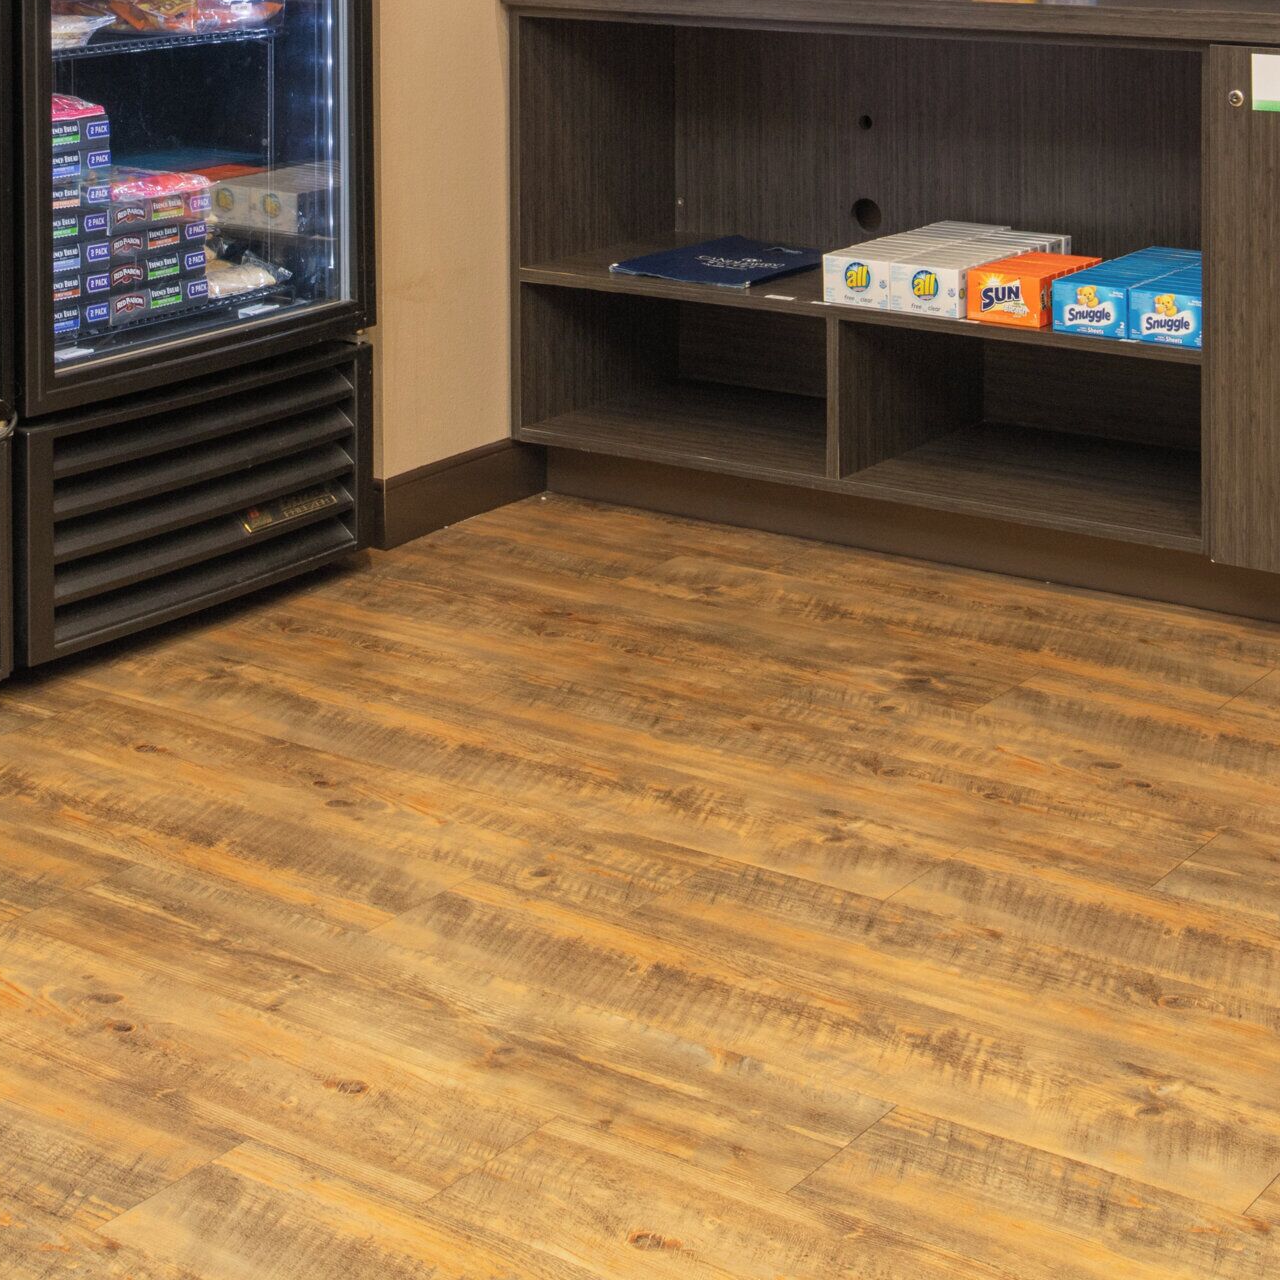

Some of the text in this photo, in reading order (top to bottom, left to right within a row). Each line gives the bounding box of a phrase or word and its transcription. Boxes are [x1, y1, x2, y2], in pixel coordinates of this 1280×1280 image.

[96, 125, 107, 133] PACK
[96, 155, 108, 163] PACK
[96, 248, 108, 256] PACK
[846, 266, 867, 288] all
[914, 274, 935, 296] all
[981, 286, 1020, 310] SUN
[1068, 307, 1110, 324] Snuggle
[1146, 316, 1190, 331] Snuggle
